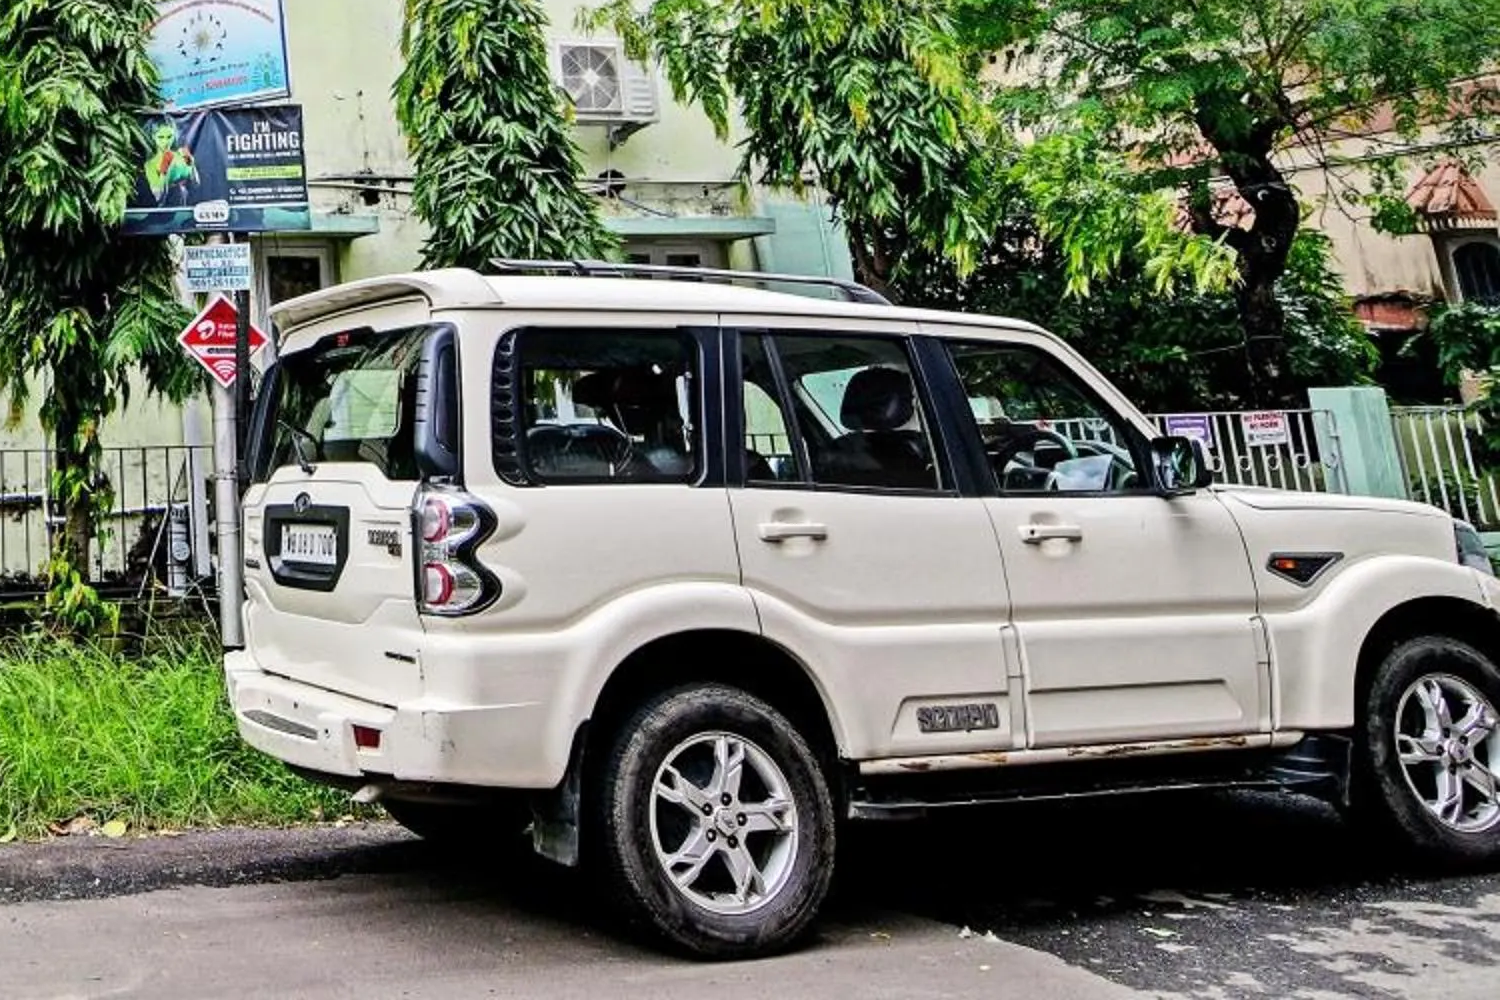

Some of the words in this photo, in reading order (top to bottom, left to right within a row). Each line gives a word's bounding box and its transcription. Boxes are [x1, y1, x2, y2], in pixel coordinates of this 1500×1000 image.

[253, 120, 270, 133] I'M
[227, 131, 299, 152] FIGHTING
[187, 246, 248, 260] MATHEMATICS
